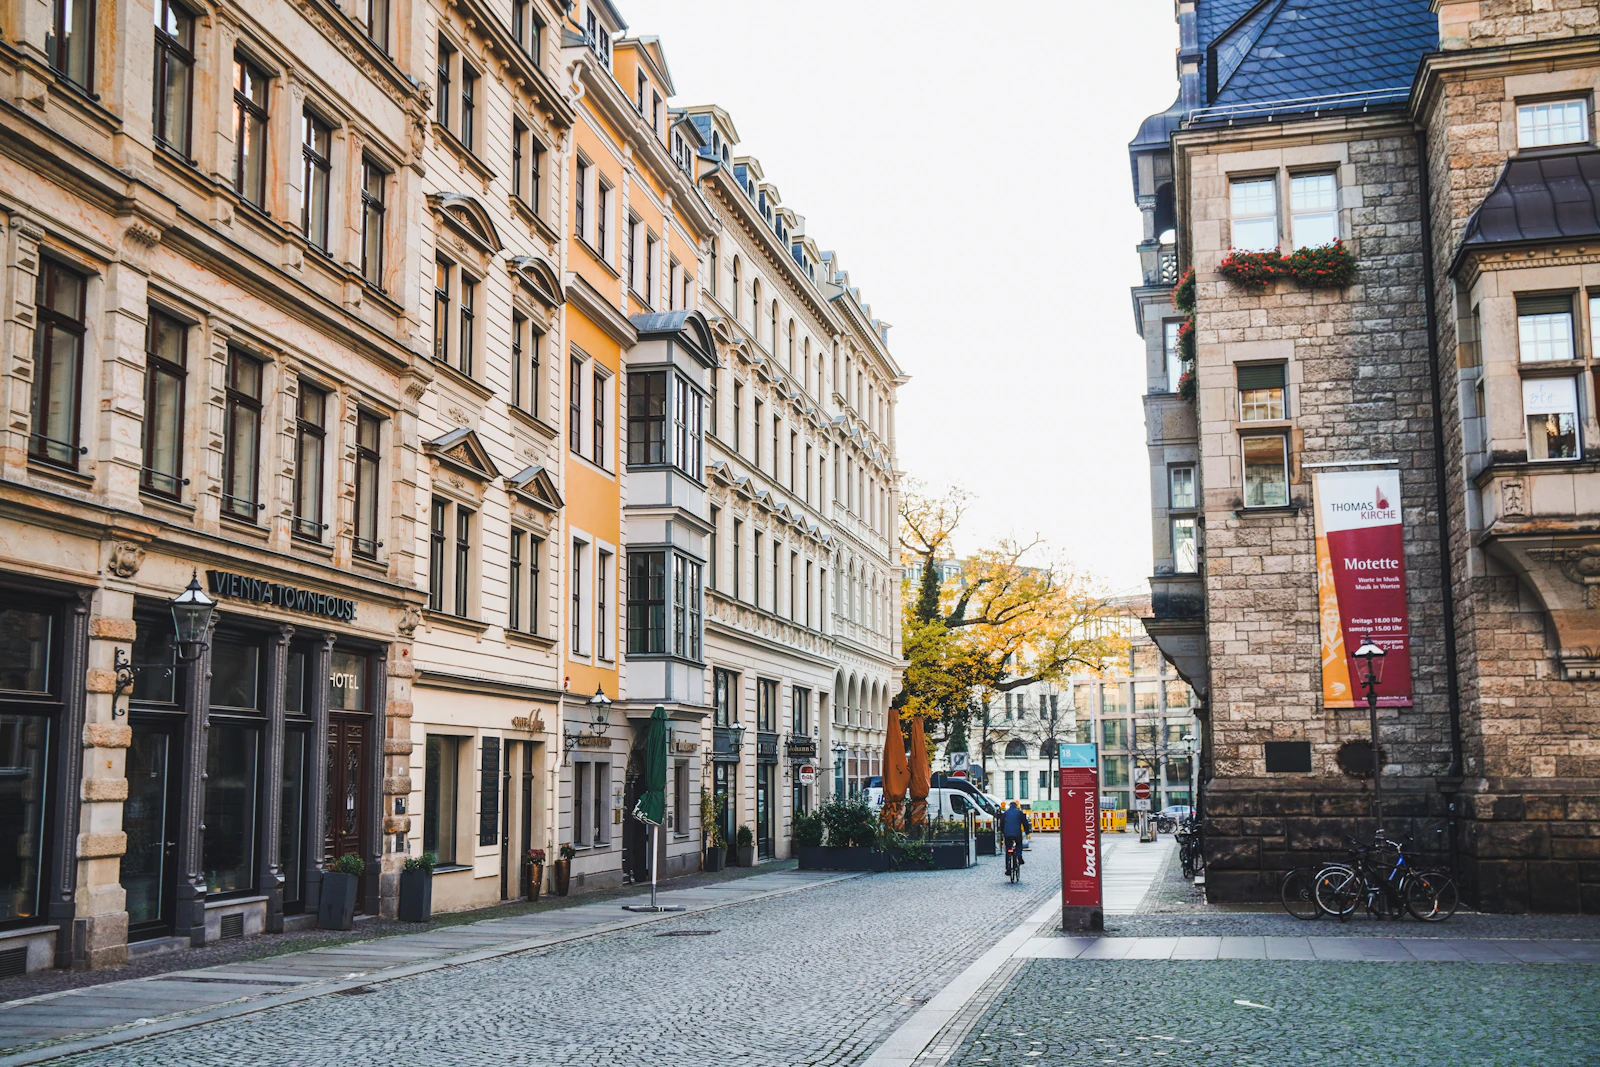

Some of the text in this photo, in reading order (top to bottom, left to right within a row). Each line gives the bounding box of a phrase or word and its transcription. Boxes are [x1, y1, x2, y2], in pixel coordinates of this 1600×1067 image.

[1331, 502, 1374, 512] THOMAS
[1361, 510, 1396, 519] KIRCHE
[1344, 558, 1399, 570] Motette
[209, 570, 358, 621] VIENNA TOWNHOUSE
[330, 672, 359, 690] HOTEL
[1062, 750, 1071, 758] 18
[1083, 791, 1096, 877] bach MUSEUM
